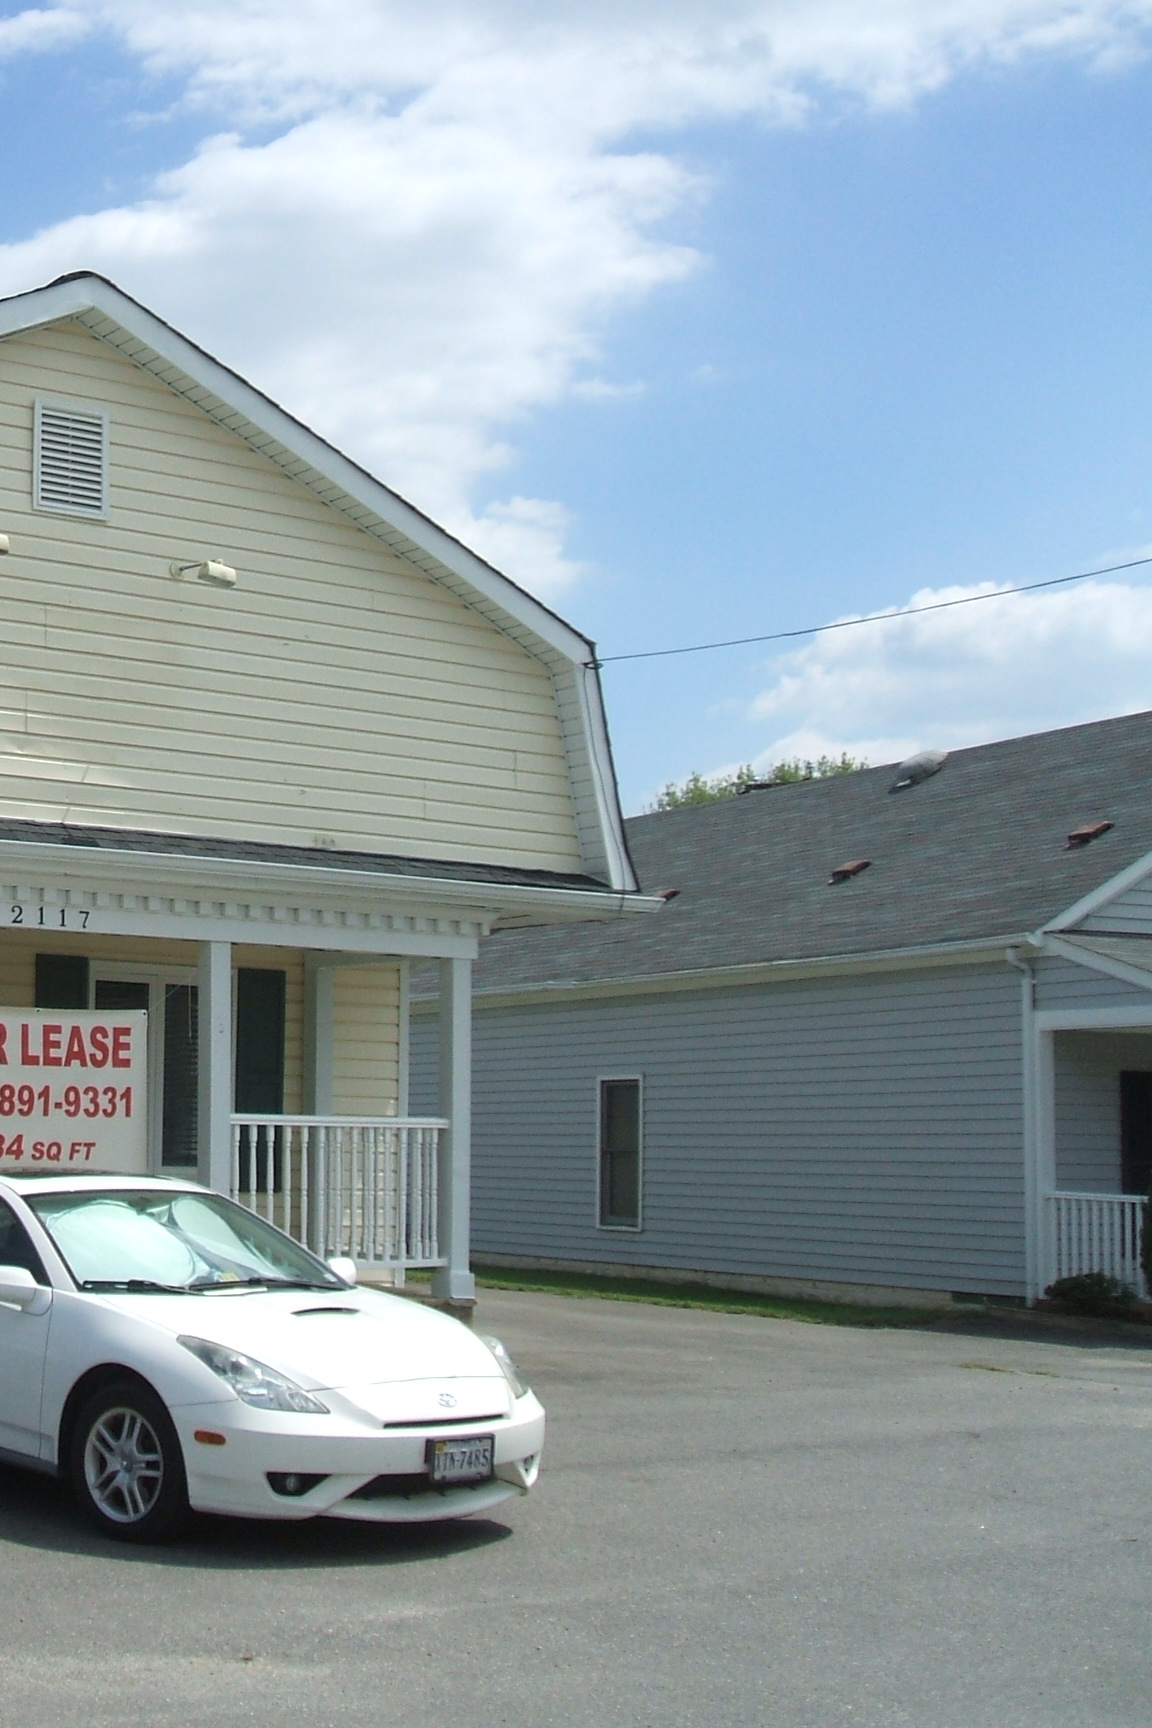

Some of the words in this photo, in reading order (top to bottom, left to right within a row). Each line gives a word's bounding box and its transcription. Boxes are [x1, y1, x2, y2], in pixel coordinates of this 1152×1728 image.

[11, 905, 90, 929] 2117
[20, 1023, 132, 1069] LEASE
[31, 1142, 62, 1162] SQ
[68, 1142, 96, 1161] FT
